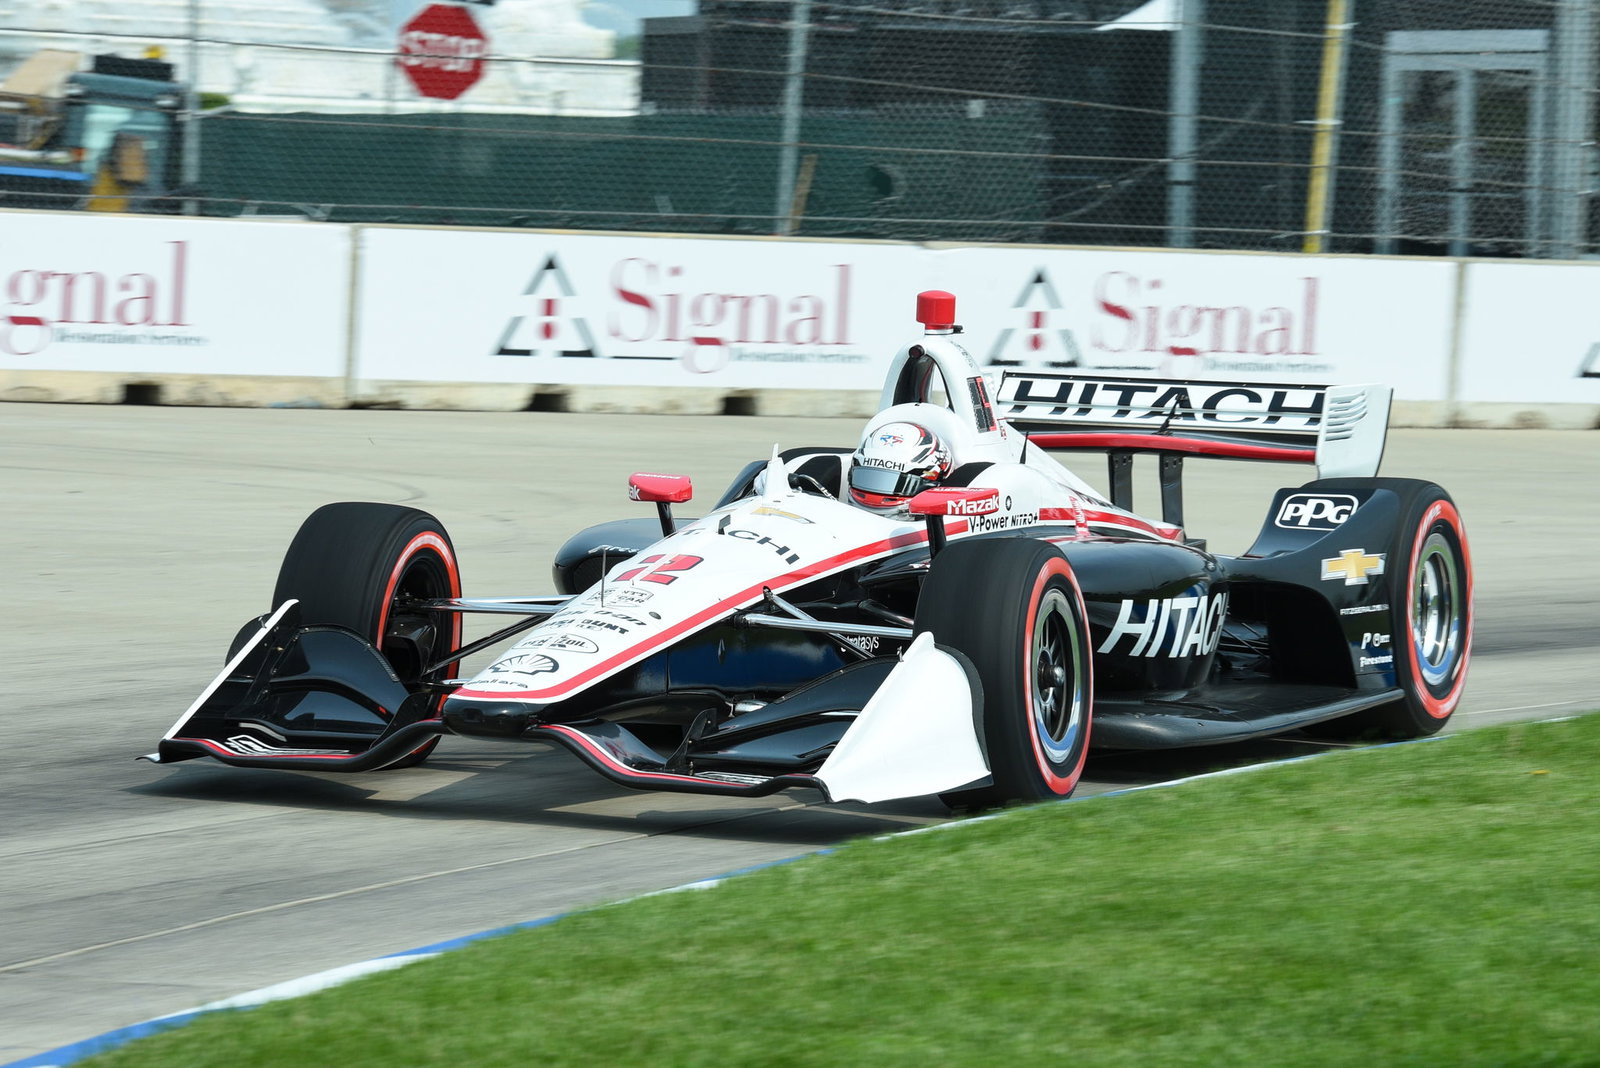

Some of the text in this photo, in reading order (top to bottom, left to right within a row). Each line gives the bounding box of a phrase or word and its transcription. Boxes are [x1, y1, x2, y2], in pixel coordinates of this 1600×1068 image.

[0, 240, 192, 355] gnal
[607, 257, 855, 374] Signal
[1091, 271, 1321, 379] Signal
[1008, 381, 1324, 426] HITACH
[863, 457, 906, 472] HITACHI
[946, 495, 1000, 515] Mazak
[968, 516, 1009, 533] V-Power
[1281, 498, 1353, 526] PPG
[1096, 590, 1230, 658] HITACH
